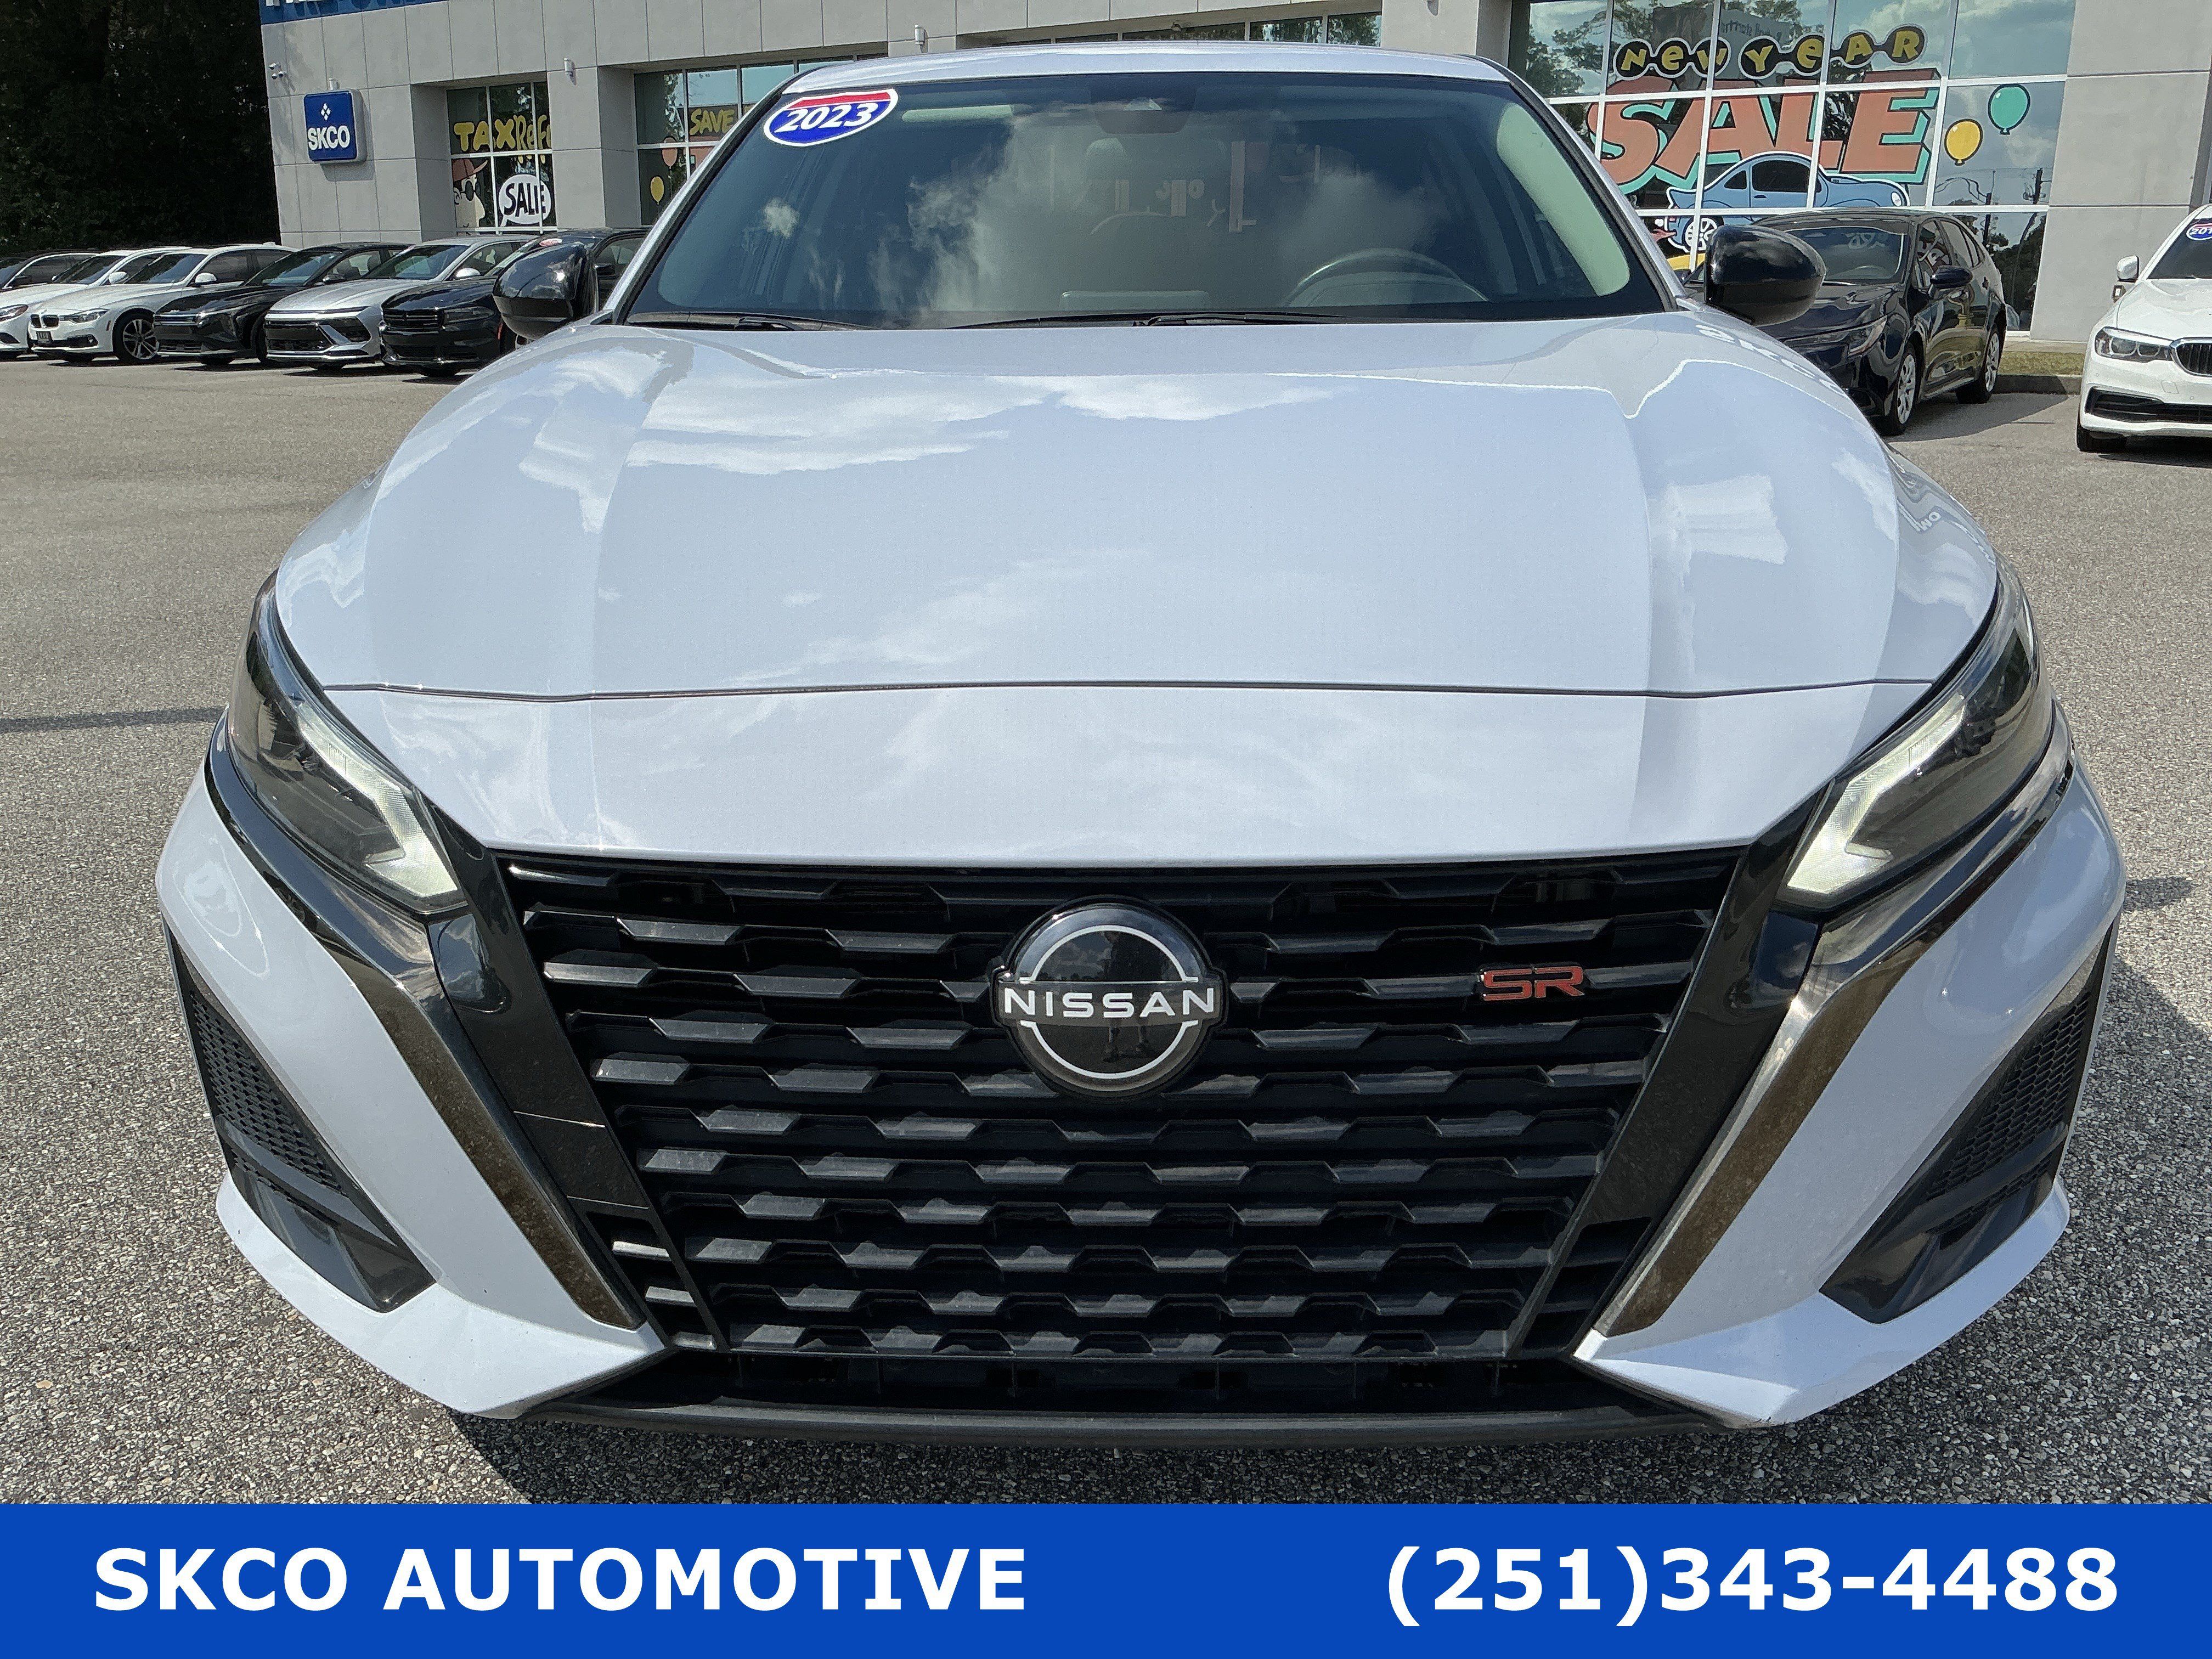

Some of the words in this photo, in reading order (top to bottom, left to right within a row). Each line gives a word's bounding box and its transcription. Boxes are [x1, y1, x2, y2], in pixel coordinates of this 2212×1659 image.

[689, 108, 736, 136] SAVE
[774, 103, 878, 133] 2023
[1588, 70, 1939, 190] SALE
[307, 125, 351, 151] SKCO
[453, 119, 516, 151] TAX
[503, 182, 546, 218] SALE
[1483, 966, 1585, 1001] SR
[1004, 987, 1215, 1018] NISSAN
